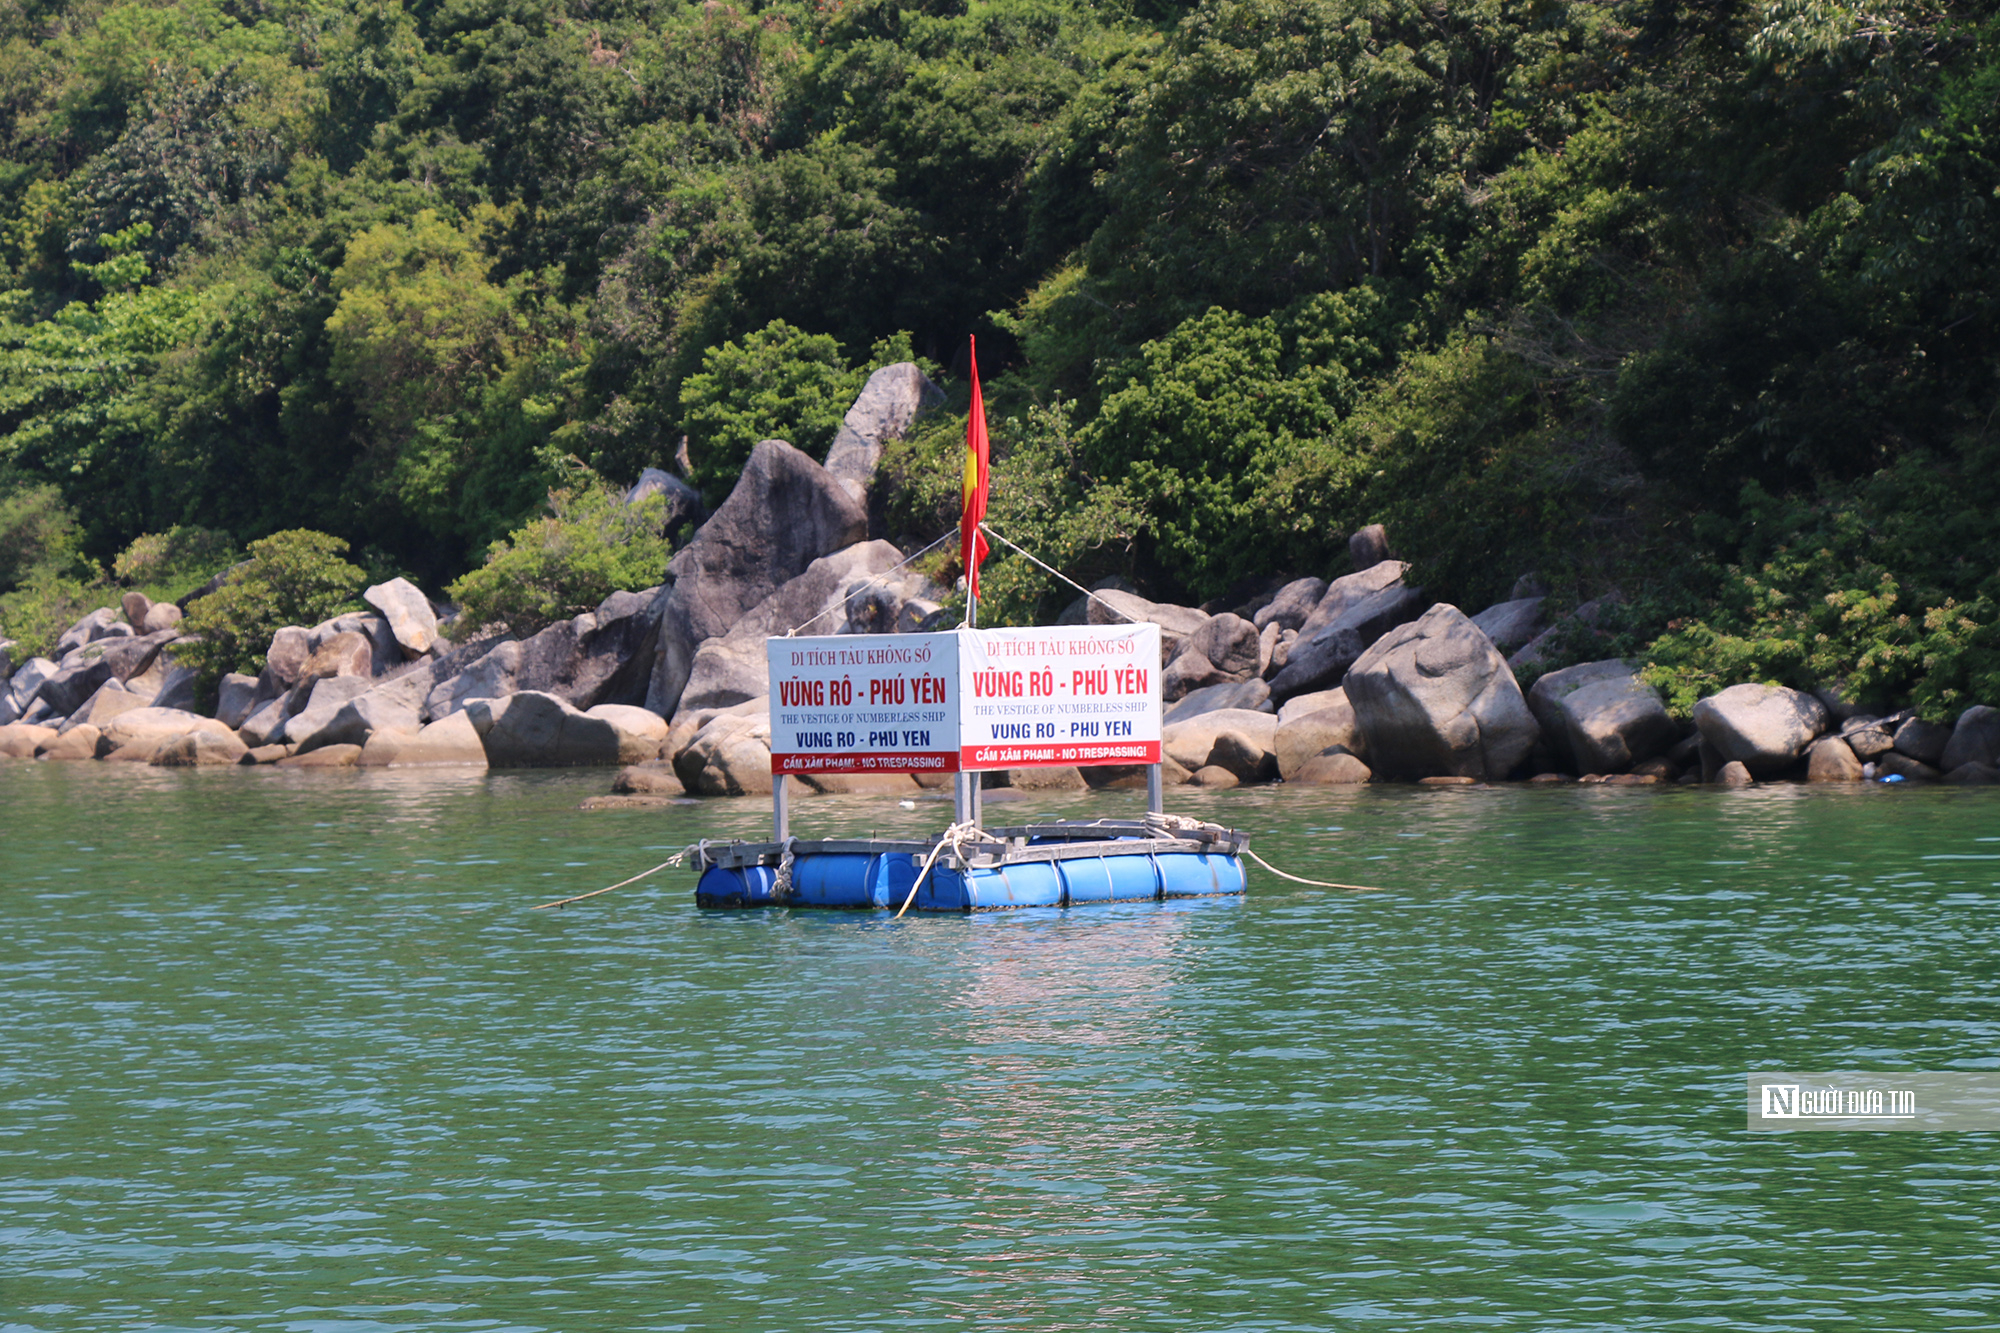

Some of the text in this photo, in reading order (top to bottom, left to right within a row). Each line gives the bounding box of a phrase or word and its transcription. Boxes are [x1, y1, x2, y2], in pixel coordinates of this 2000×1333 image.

[807, 648, 836, 665] TÍCH
[868, 645, 911, 664] KHÔNG
[915, 642, 931, 663] SỐ
[1004, 637, 1035, 656] TÍCH
[1069, 636, 1114, 654] KHÔNG
[1118, 634, 1134, 654] SỐ
[780, 676, 823, 706] VŨNG
[830, 674, 852, 705] RÔ
[870, 673, 904, 705] PHÚ
[911, 672, 945, 704] YÊN
[973, 667, 1022, 697] VŨNG
[1030, 666, 1053, 696] RÔ
[1073, 665, 1108, 695] PHÚ
[1115, 664, 1147, 694] YÊN
[974, 702, 1147, 715] THE VESTIGE OF NUMBERLESS SHIP
[781, 712, 945, 724] THE VESTIGE OF NUMBERLESS SHIP
[991, 724, 1030, 739] VUNG
[1036, 723, 1055, 738] RO
[1071, 722, 1099, 737] PHU
[1105, 721, 1131, 736] YEN
[796, 732, 832, 747] VUNG
[837, 732, 855, 747] RO
[870, 731, 897, 746] PHU
[903, 731, 929, 745] YEN
[784, 755, 803, 769] CẤM
[805, 757, 823, 768] XÂM
[862, 759, 876, 768] NO
[878, 757, 945, 767] TRESPASSING!
[976, 747, 997, 761] CẤM
[1000, 747, 1021, 761] XÂM
[1062, 749, 1078, 759] NO
[1078, 746, 1146, 758] TRESPASSING!
